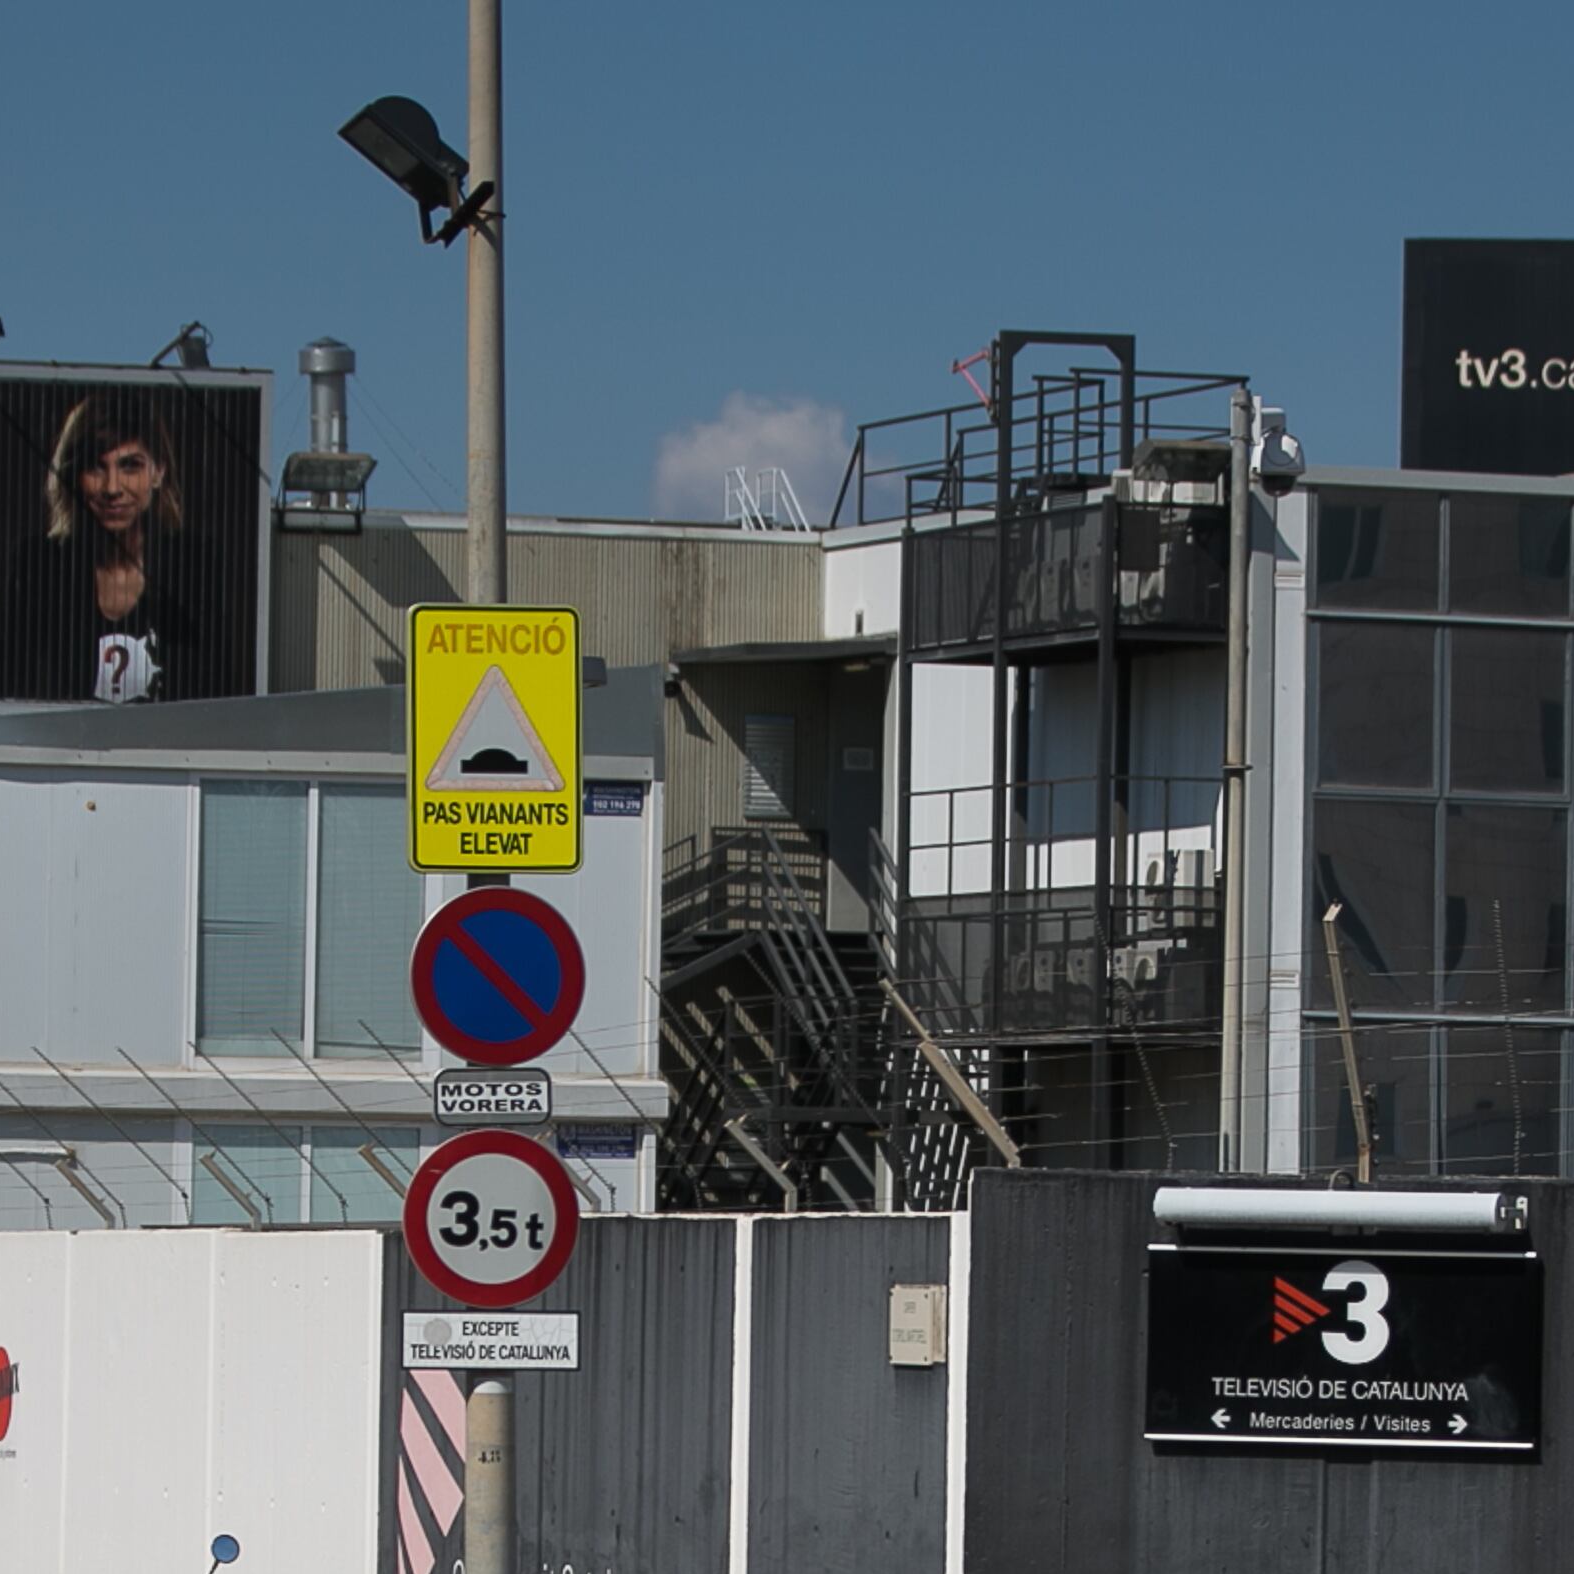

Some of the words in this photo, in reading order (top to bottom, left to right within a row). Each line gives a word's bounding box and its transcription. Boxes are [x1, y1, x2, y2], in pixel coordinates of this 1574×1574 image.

[427, 617, 567, 656] ATENCIÓ
[423, 801, 461, 825] PAS
[468, 803, 569, 826] VIANANTS
[460, 832, 533, 855] ELEVAT
[440, 1083, 543, 1097] MOTOS
[440, 1099, 544, 1112] VORERA
[1321, 1260, 1390, 1365] 3
[462, 1321, 520, 1337] EXCEPTE
[411, 1340, 475, 1360] TELEVISIÓ
[479, 1344, 496, 1360] DE
[498, 1344, 571, 1361] CATALUNYA
[1211, 1375, 1314, 1398] TELEVISIÓ
[1318, 1380, 1347, 1399] DE
[1351, 1380, 1469, 1402] CATALUNYA
[1249, 1411, 1355, 1431] Mercaderies
[1373, 1414, 1432, 1433] Visites
